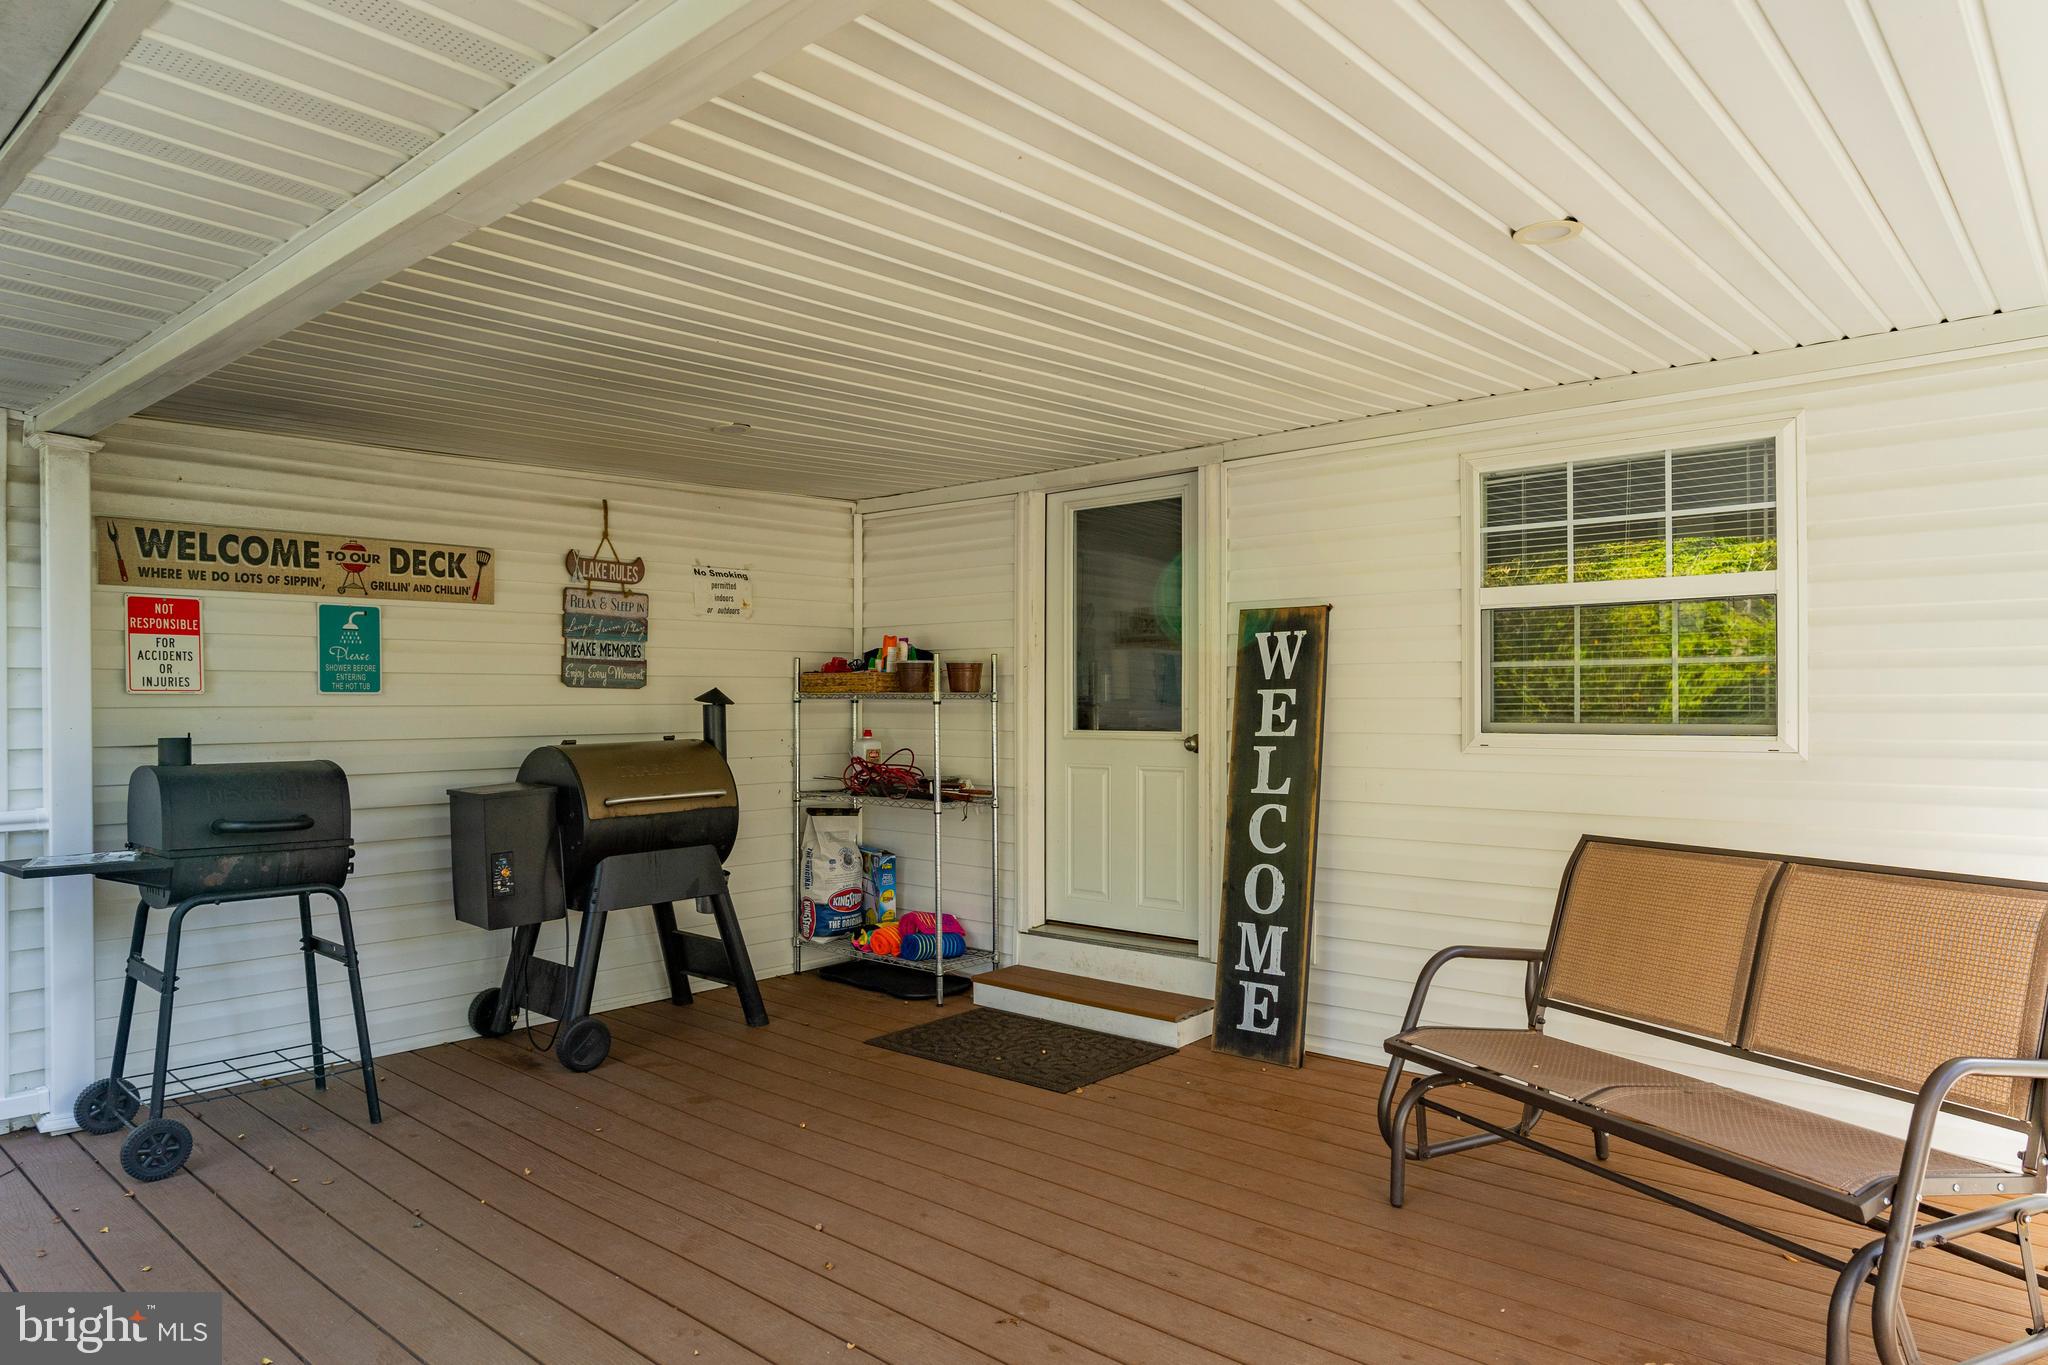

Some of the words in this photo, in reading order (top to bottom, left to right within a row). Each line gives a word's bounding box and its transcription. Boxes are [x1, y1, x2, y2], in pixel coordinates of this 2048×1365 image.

[135, 526, 320, 569] WELCOME
[325, 551, 346, 562] TO
[350, 552, 380, 564] OUR
[389, 547, 467, 579] DECK
[583, 561, 607, 579] LAKE
[609, 563, 639, 582] RULES
[694, 568, 706, 576] No
[709, 569, 748, 581] Smoking
[138, 566, 182, 579] WHERE
[188, 570, 206, 581] WE
[212, 571, 230, 582] DO
[235, 572, 263, 584] LOTS
[268, 575, 281, 584] OF
[370, 580, 410, 592] GRILLIN'
[413, 584, 432, 593] AND
[434, 584, 471, 596] CHILLIN'
[154, 603, 174, 614] NOT
[130, 617, 199, 630] RESPONSIBLE
[155, 637, 175, 648] FOR
[137, 650, 193, 661] ACCIDENTS
[329, 646, 370, 662] Please
[570, 641, 596, 656] MAKE
[600, 642, 642, 658] MEMORIES
[159, 663, 173, 674] OR
[325, 663, 352, 672] SHOWER
[353, 664, 377, 672] BEFORE
[336, 673, 367, 681] ENTERING
[565, 663, 585, 685] Enjoy
[588, 663, 608, 686] Every
[608, 665, 645, 680] Moment
[142, 676, 190, 687] INJURIES
[332, 682, 344, 690] THE
[345, 682, 357, 690] HOT
[359, 682, 371, 690] TUB
[1234, 630, 1307, 1036] WELCOME
[828, 920, 840, 929] THE
